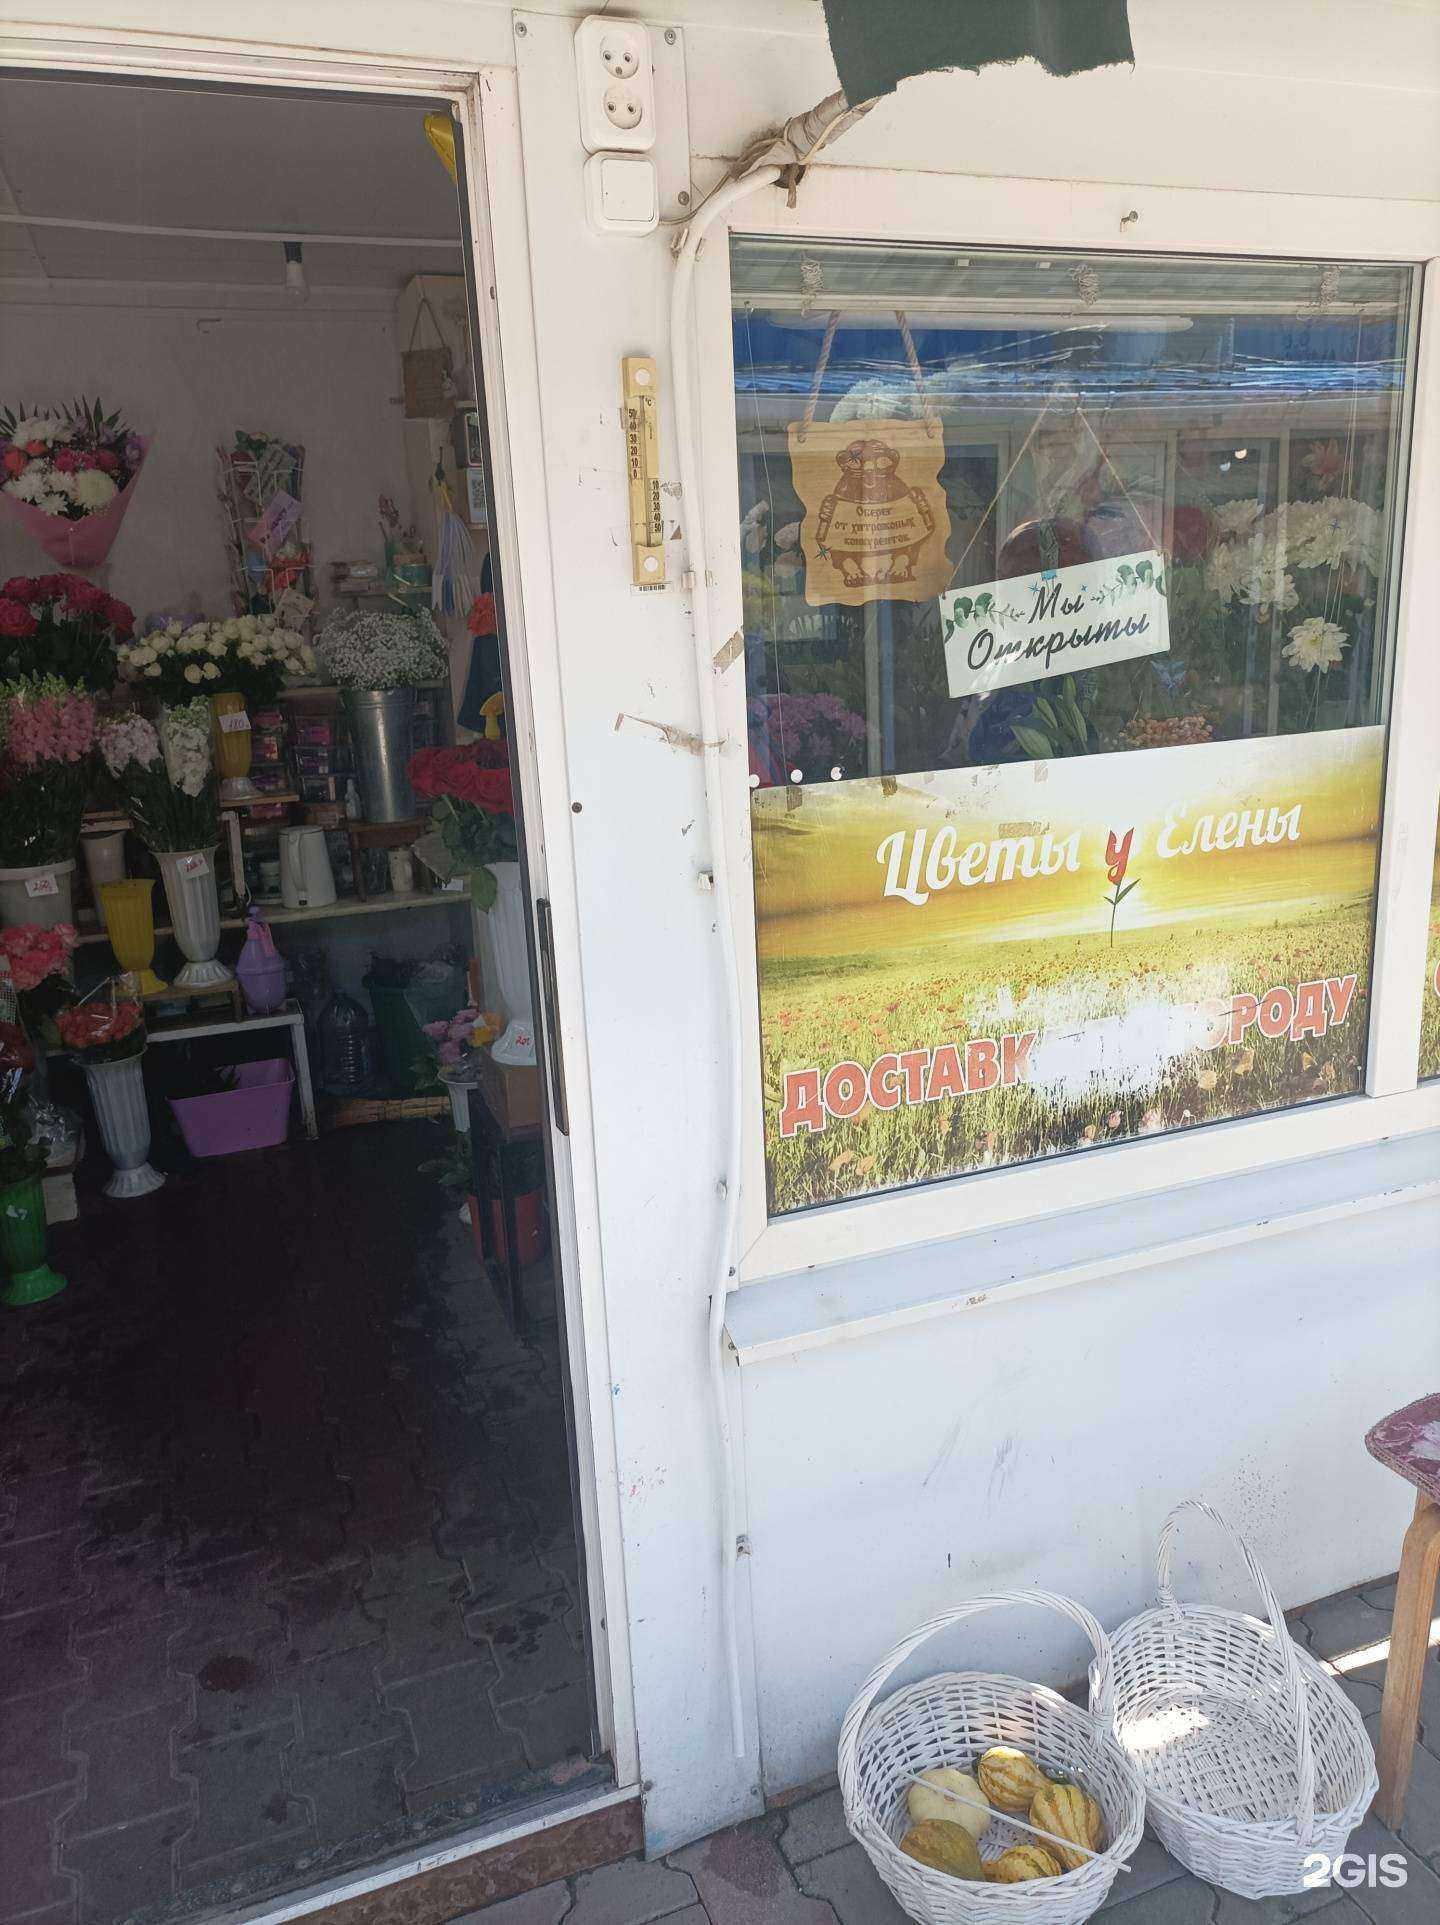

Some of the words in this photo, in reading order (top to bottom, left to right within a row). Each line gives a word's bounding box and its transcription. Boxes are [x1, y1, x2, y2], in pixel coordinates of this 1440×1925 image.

[629, 433, 637, 444] 30
[630, 446, 638, 455] 20
[631, 457, 639, 467] 10
[633, 469, 638, 479] 0
[652, 480, 660, 490] 10
[652, 491, 660, 500] 20
[653, 501, 661, 510] 30
[653, 512, 661, 521] 40
[654, 522, 662, 532] 50
[834, 521, 848, 530] от
[1029, 582, 1085, 624] Мы
[967, 613, 1150, 670] Открыты
[875, 825, 1081, 906] Цветы
[1156, 800, 1302, 859] Елены
[779, 1029, 1039, 1138] ДОСТАВК
